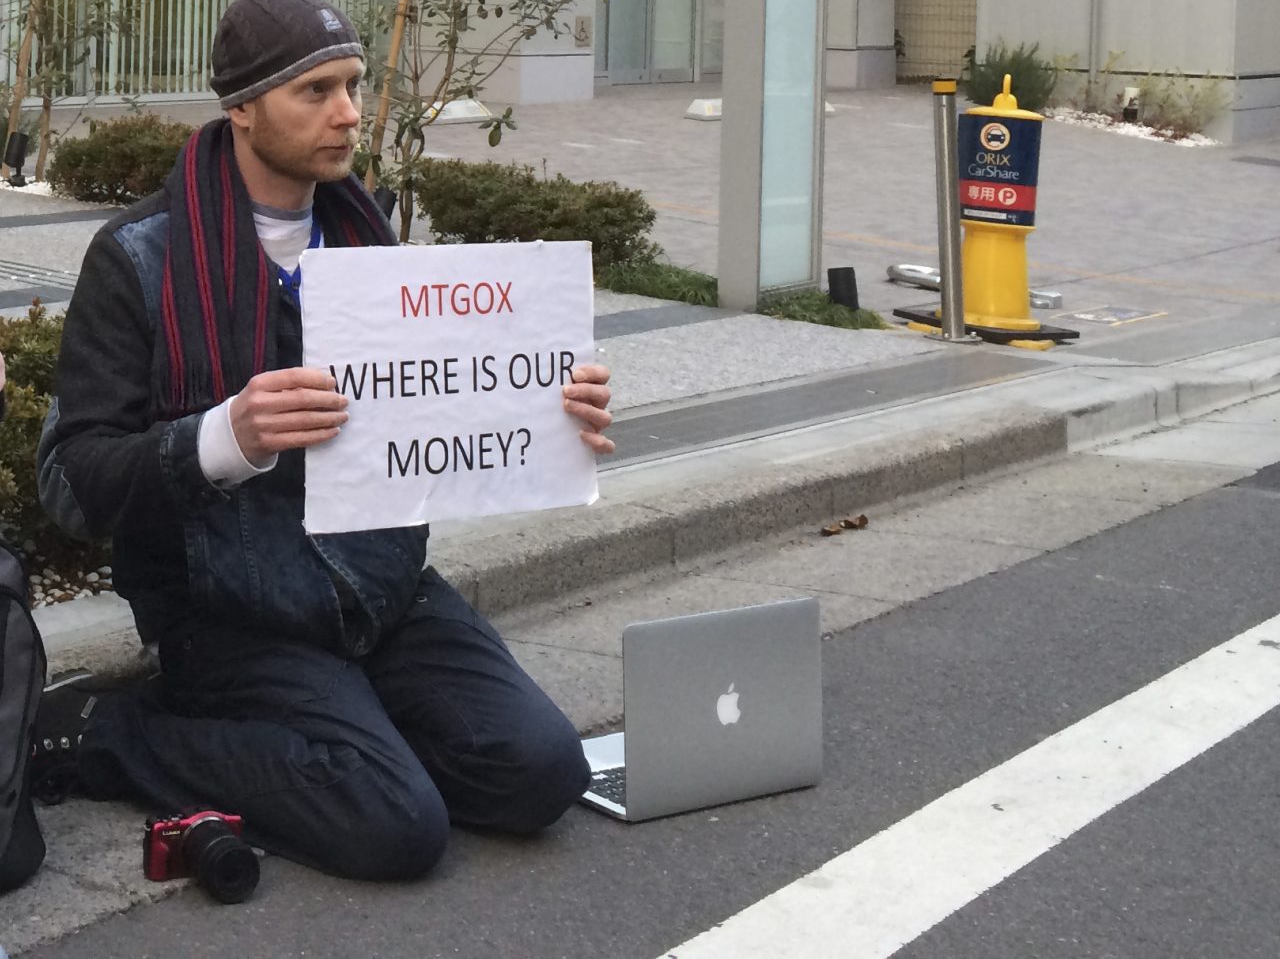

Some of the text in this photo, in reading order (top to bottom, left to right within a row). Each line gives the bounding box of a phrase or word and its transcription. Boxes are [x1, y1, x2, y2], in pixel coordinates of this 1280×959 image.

[968, 163, 1020, 179] CarShare
[975, 152, 1011, 166] ORIX
[968, 185, 996, 202] 専用
[400, 281, 514, 318] MTGOX
[329, 350, 576, 401] WHERE IS OUR
[387, 427, 532, 478] MONEY?
